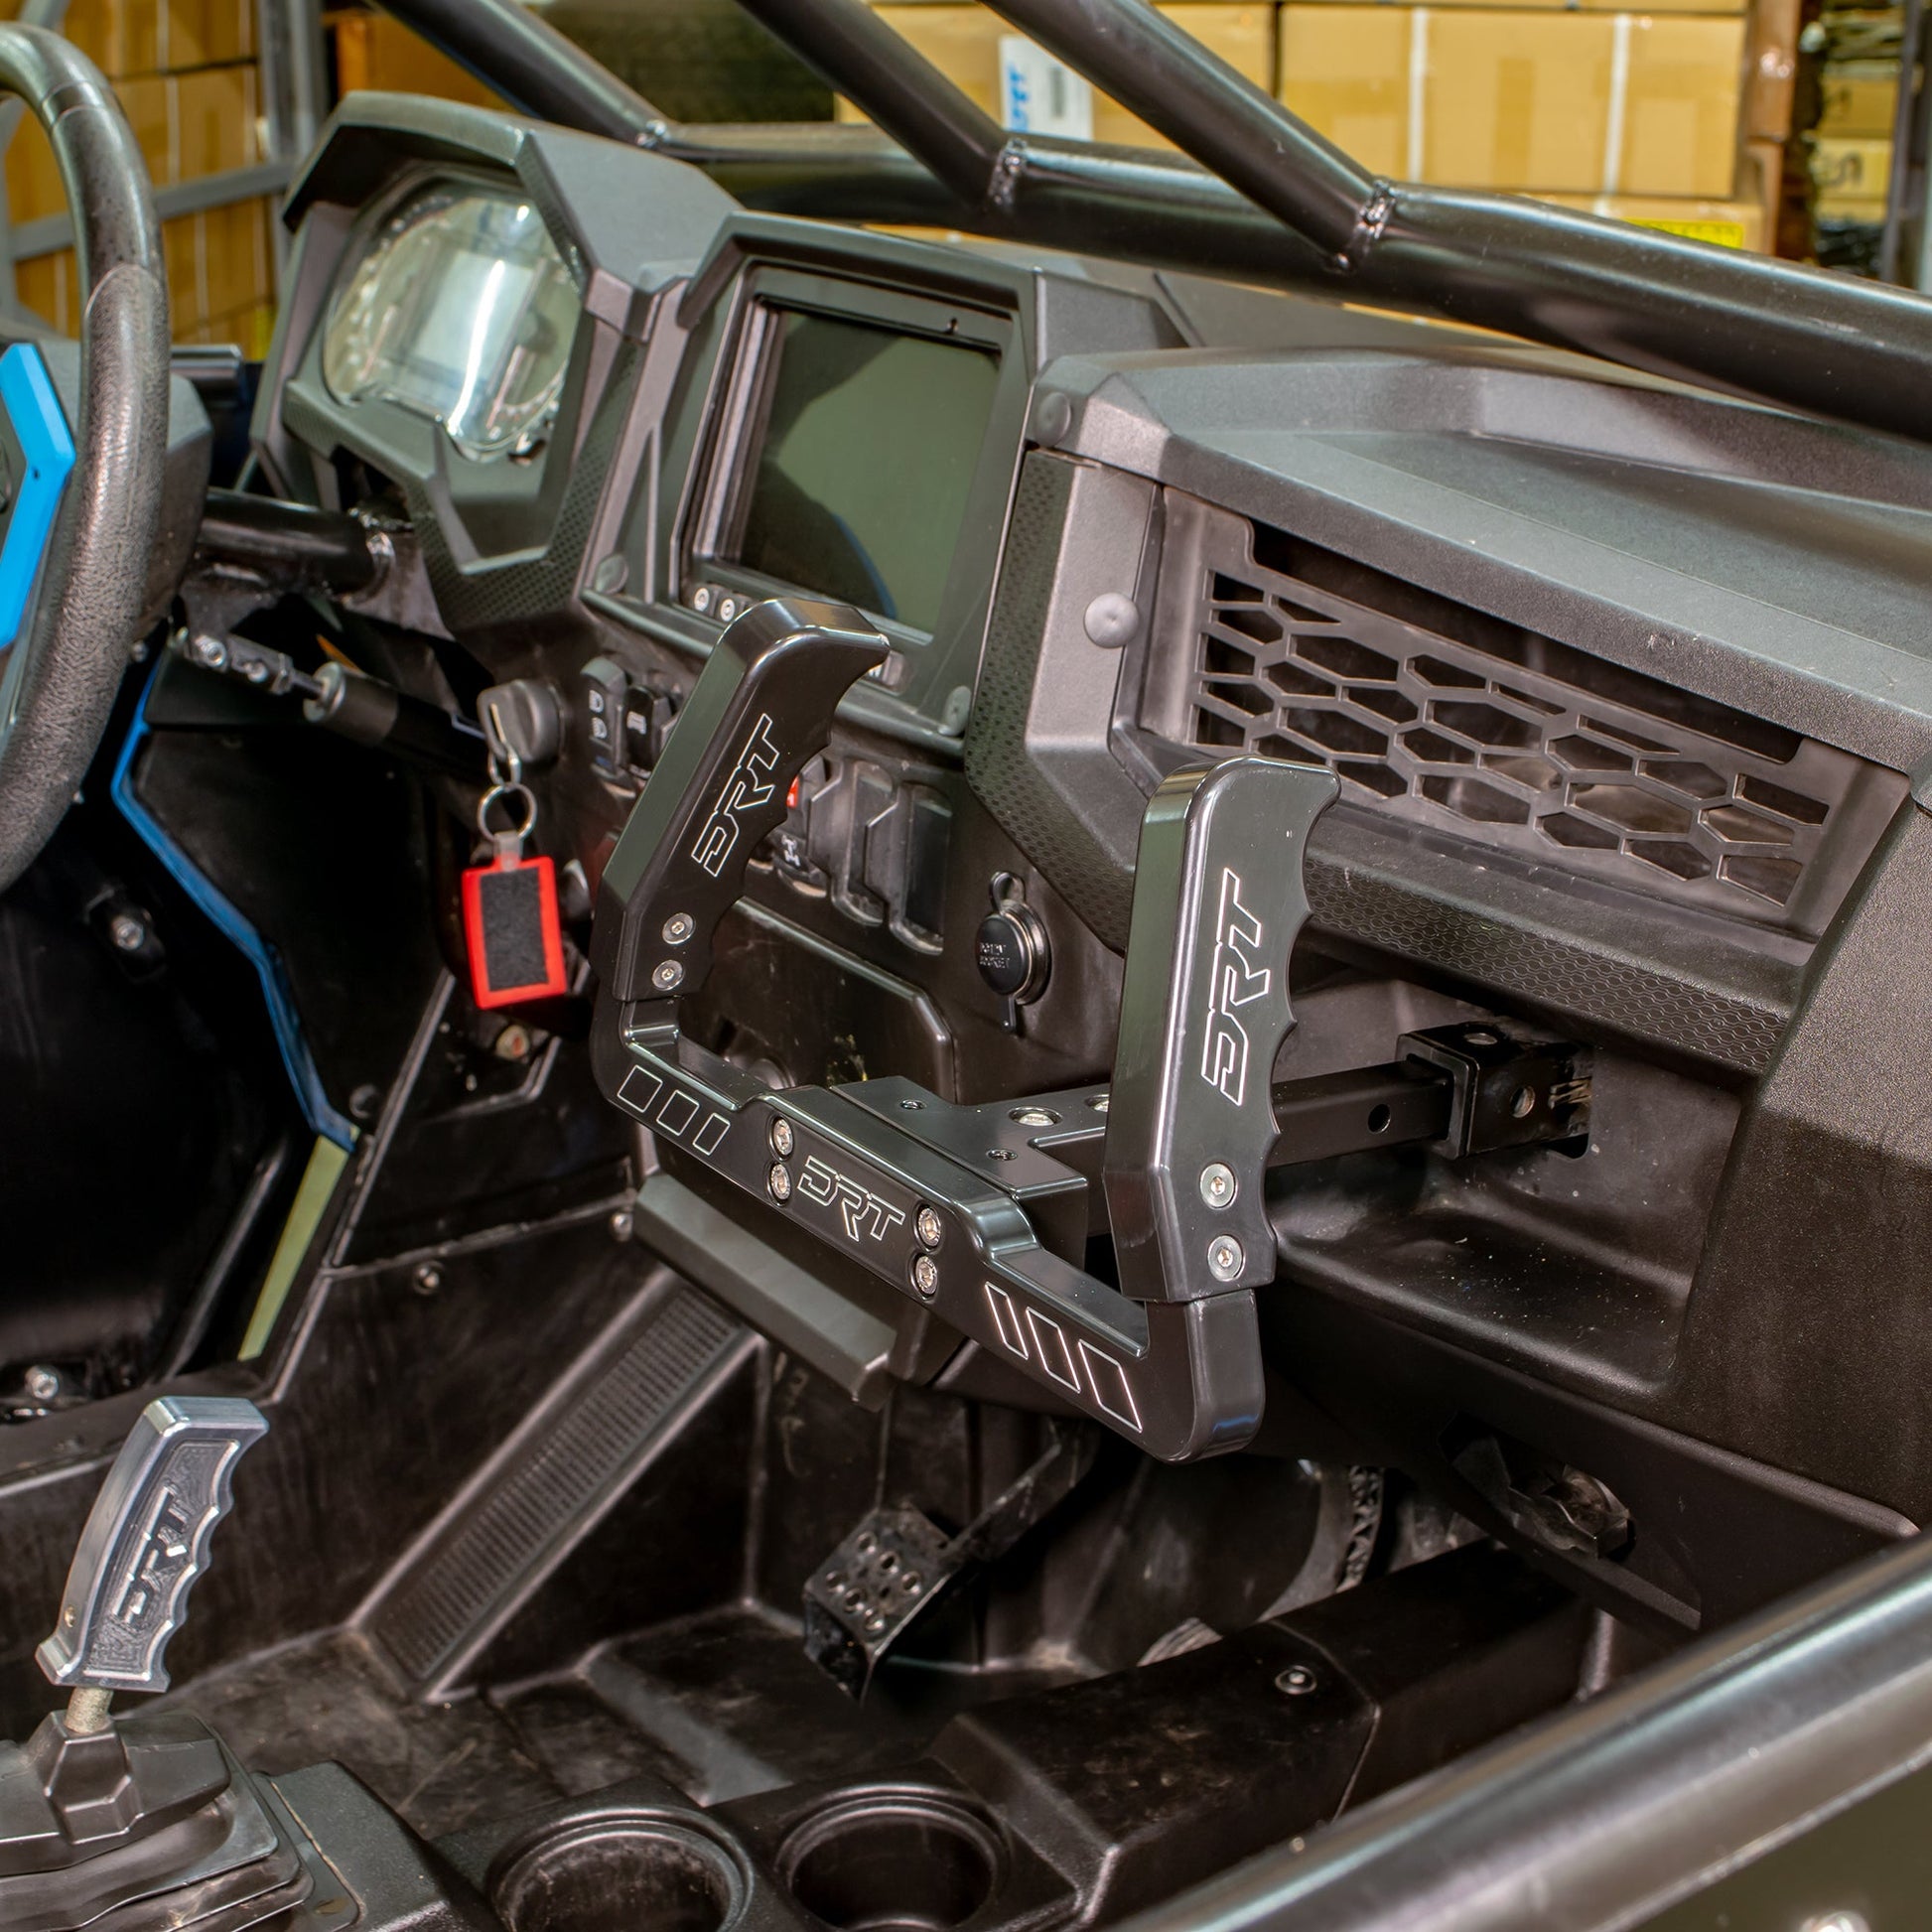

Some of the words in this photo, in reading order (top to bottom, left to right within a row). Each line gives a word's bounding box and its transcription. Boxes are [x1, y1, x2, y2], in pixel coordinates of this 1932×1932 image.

[691, 713, 780, 878] DRT
[1201, 867, 1271, 1107] DRT
[797, 1155, 906, 1242] DRT
